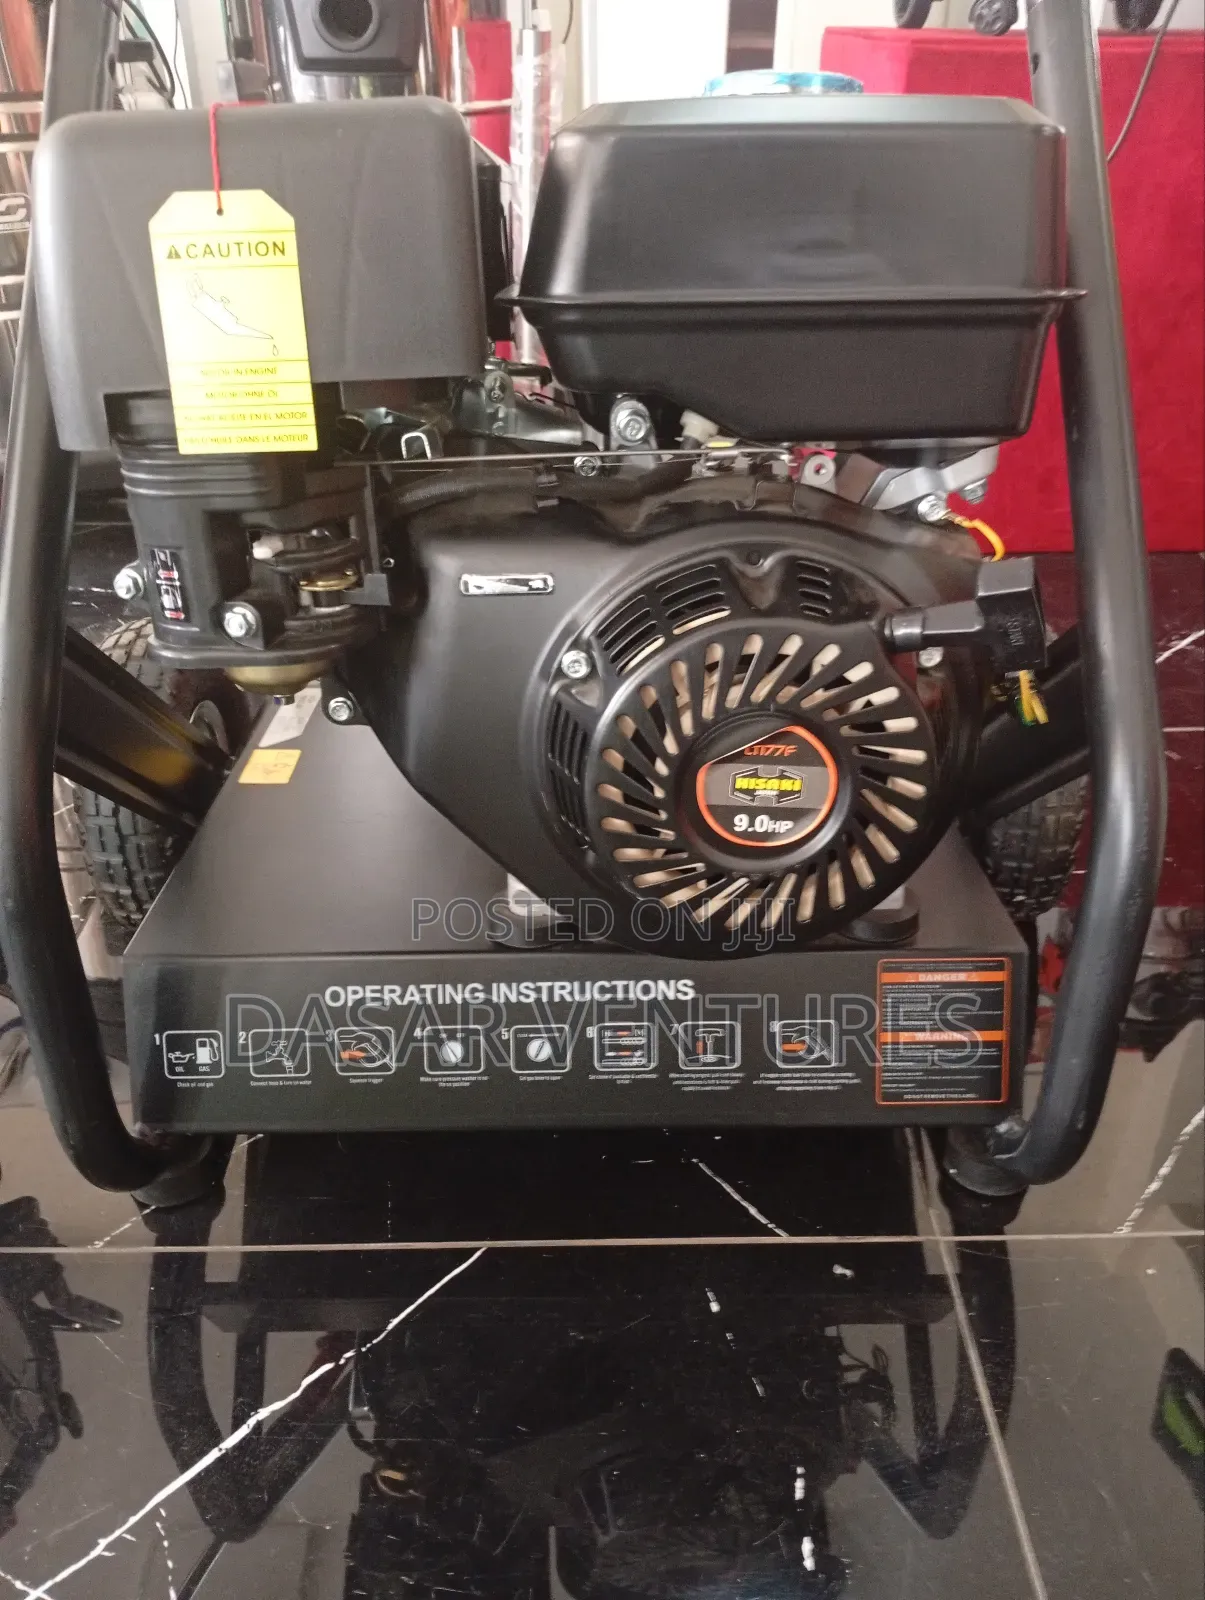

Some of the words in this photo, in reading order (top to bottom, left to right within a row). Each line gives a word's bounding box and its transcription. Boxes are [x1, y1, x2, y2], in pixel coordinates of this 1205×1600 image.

[185, 241, 286, 258] CAUTION
[245, 366, 277, 376] ENGINE
[275, 411, 308, 420] MOTOR
[236, 435, 260, 443] DANS
[273, 433, 309, 443] MOTEUR
[918, 973, 968, 982] DANGER
[324, 982, 486, 1008] OPERATING
[491, 979, 697, 1004] INSTRUCTIONS
[153, 1033, 160, 1046] 1
[238, 1031, 247, 1044] 2
[325, 1029, 334, 1042] 3
[413, 1027, 423, 1040] 4
[501, 1027, 510, 1040] 5
